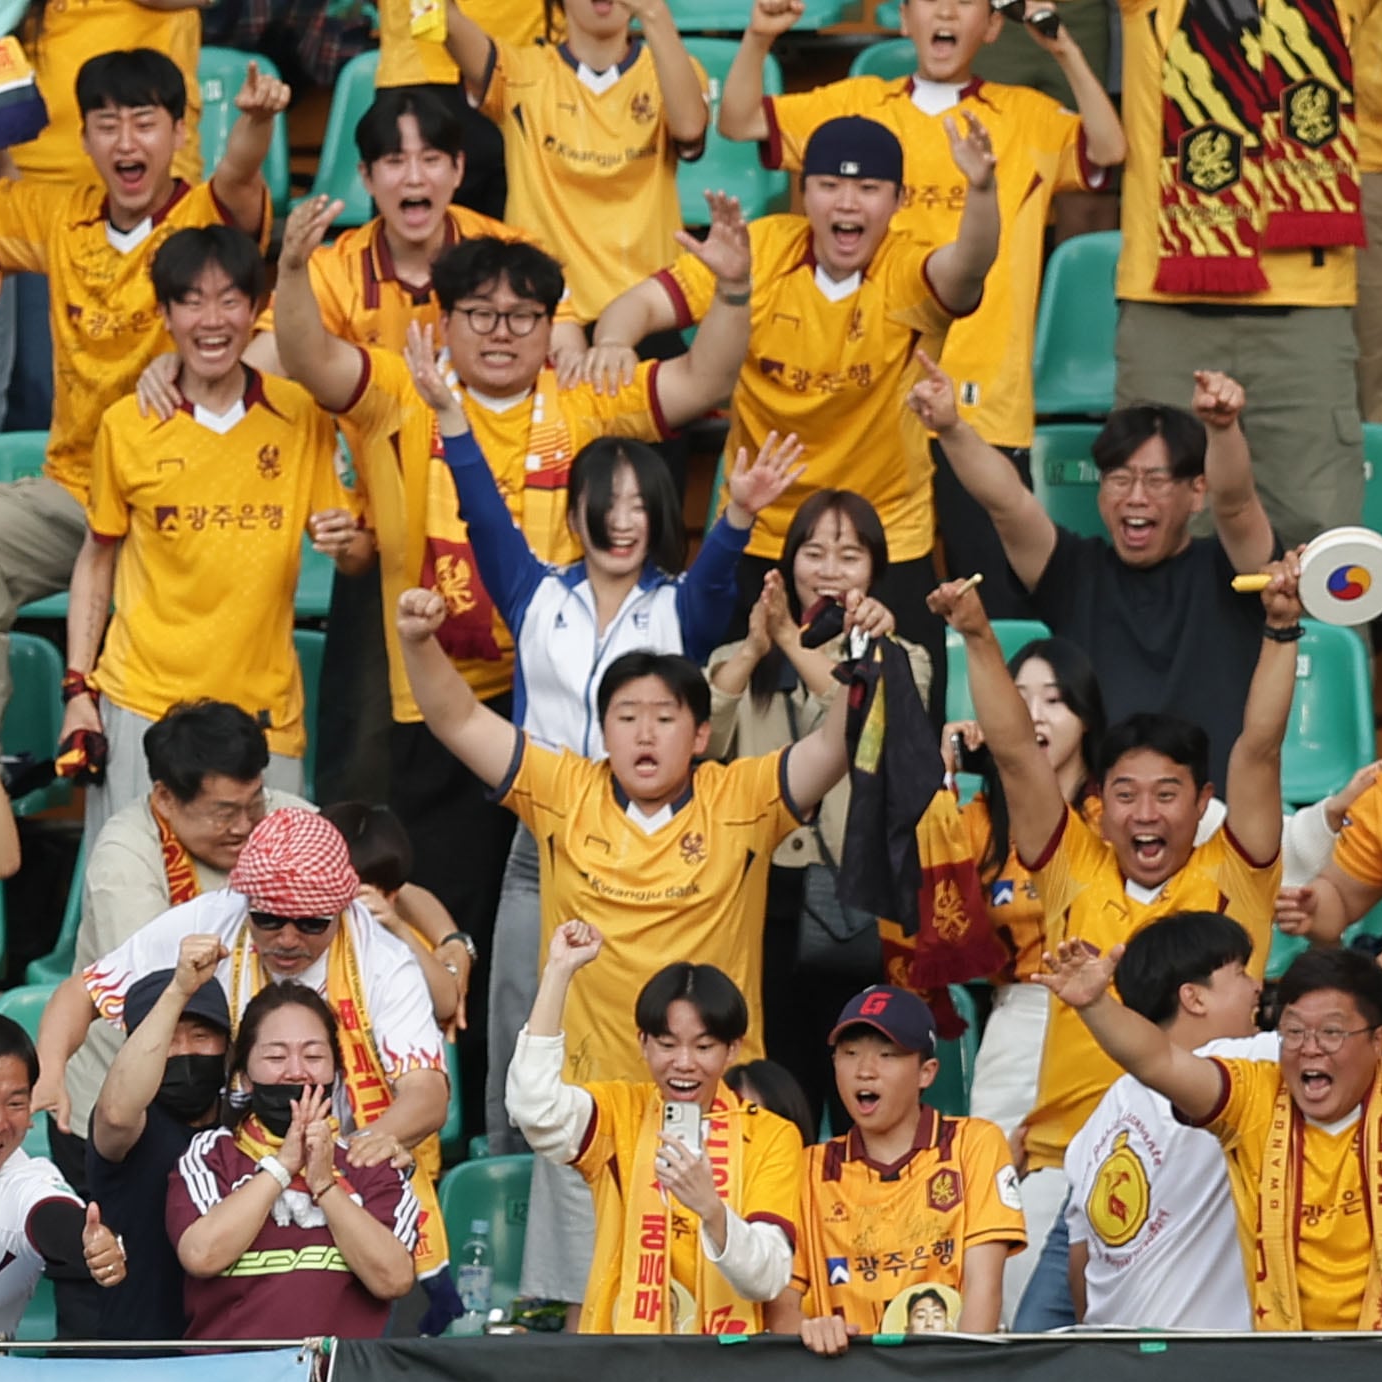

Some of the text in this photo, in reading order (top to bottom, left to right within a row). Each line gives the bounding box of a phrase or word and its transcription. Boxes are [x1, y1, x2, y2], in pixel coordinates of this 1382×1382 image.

[184, 504, 285, 533] 광주은행
[587, 875, 663, 902] Kwangju
[854, 1237, 955, 1283] 광주은행
